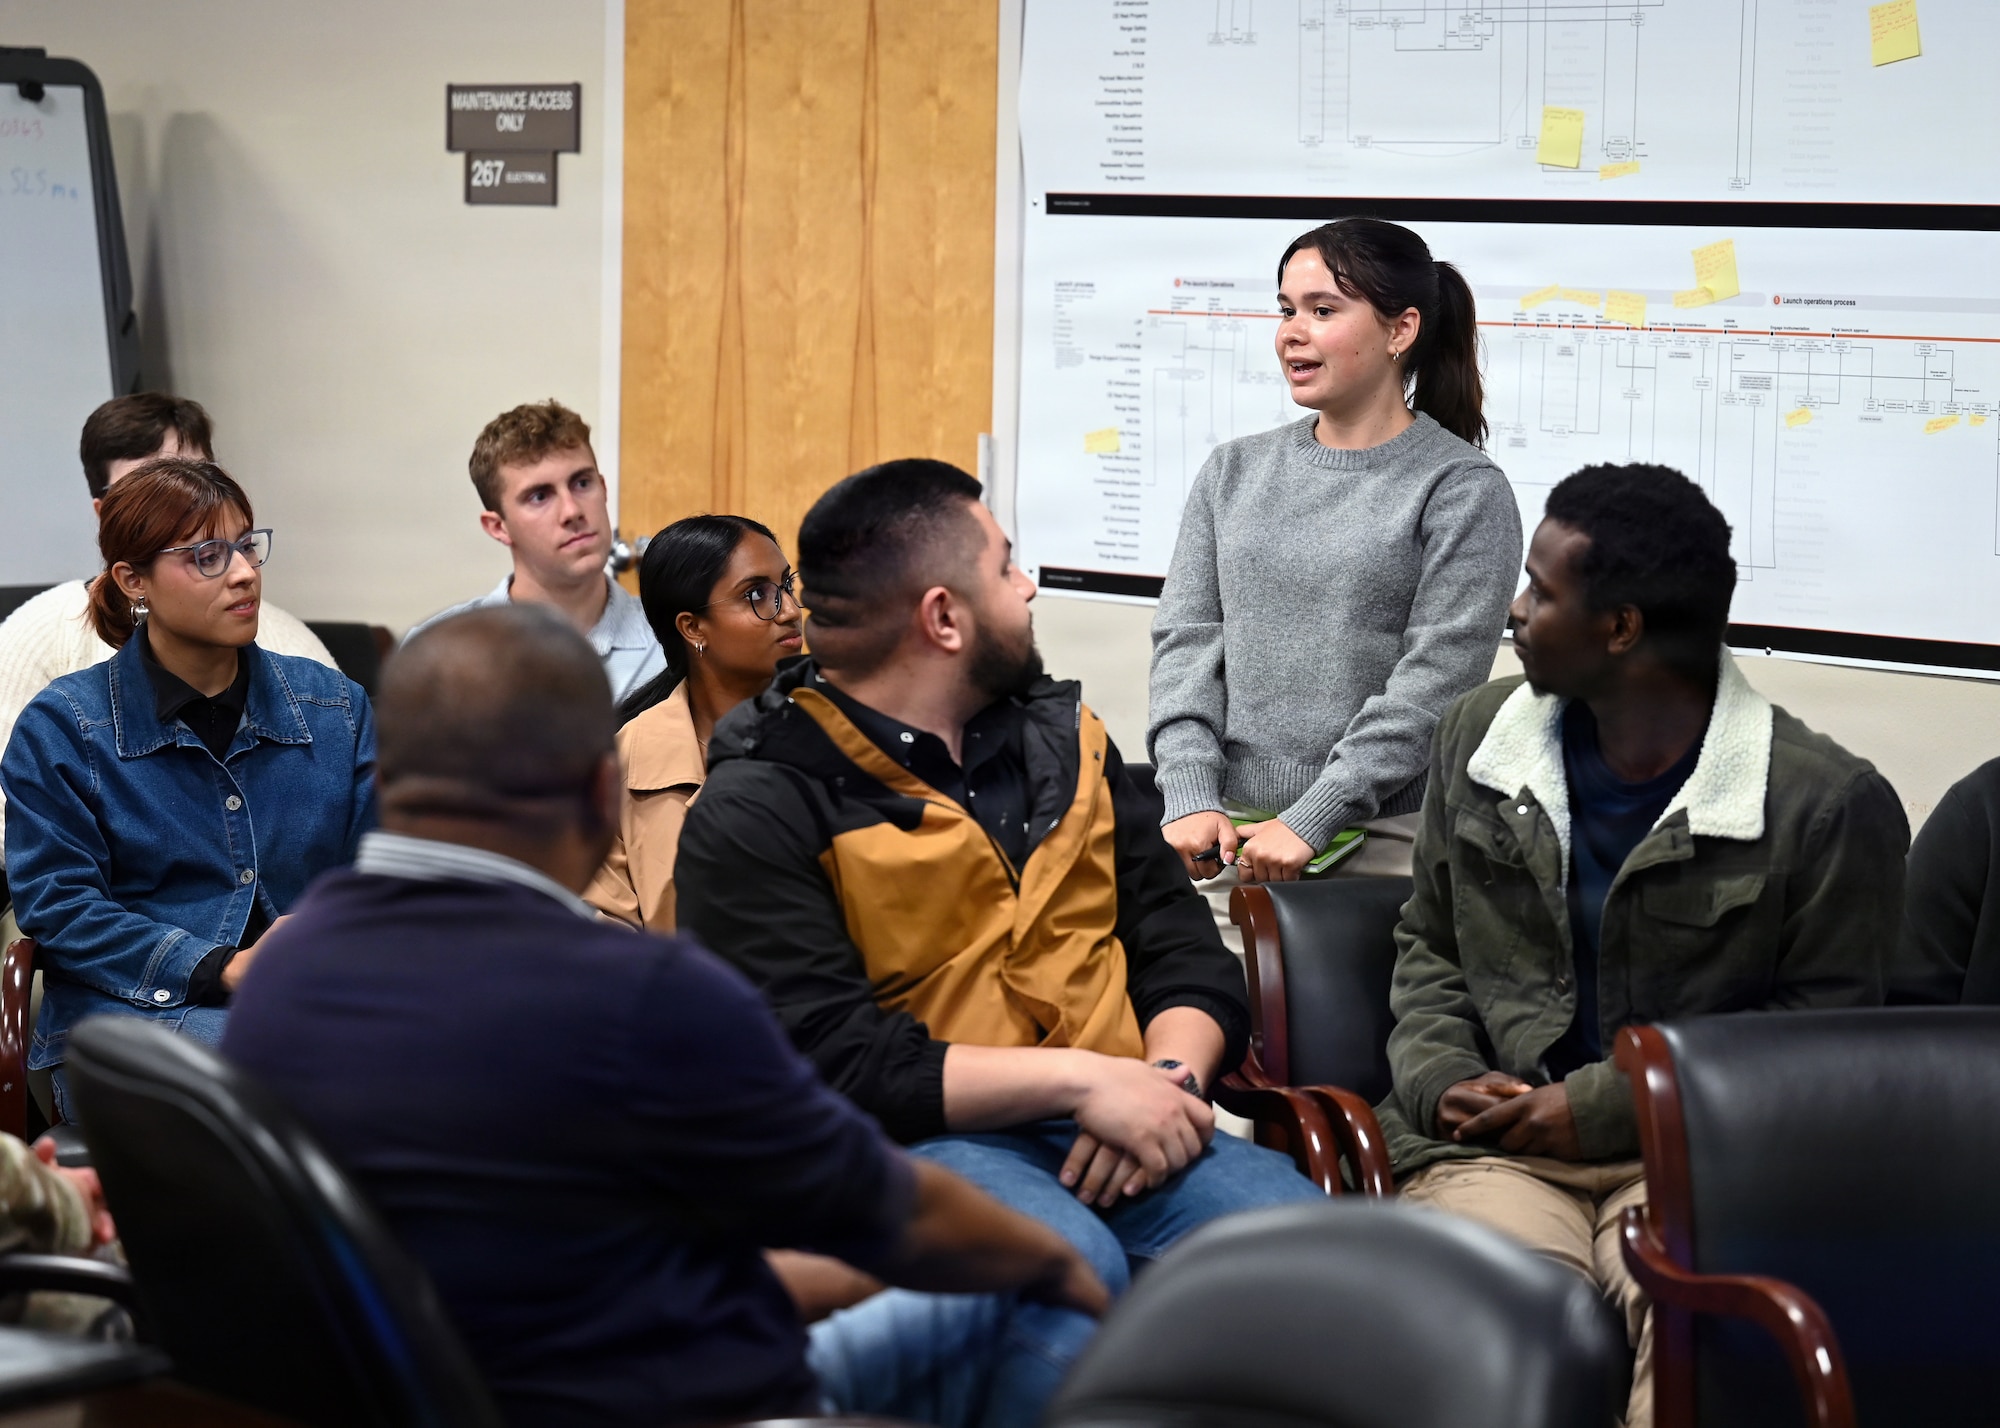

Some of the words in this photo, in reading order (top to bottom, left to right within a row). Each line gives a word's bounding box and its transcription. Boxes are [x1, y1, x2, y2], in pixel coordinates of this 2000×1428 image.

[452, 91, 528, 110] MAINTENANCE
[529, 90, 573, 110] ACCESS
[496, 111, 525, 132] ONLY
[471, 159, 505, 187] 267
[505, 171, 547, 184] ELECTRICAL
[1783, 297, 1803, 305] Launch
[1804, 297, 1833, 306] operations
[1834, 299, 1857, 308] process
